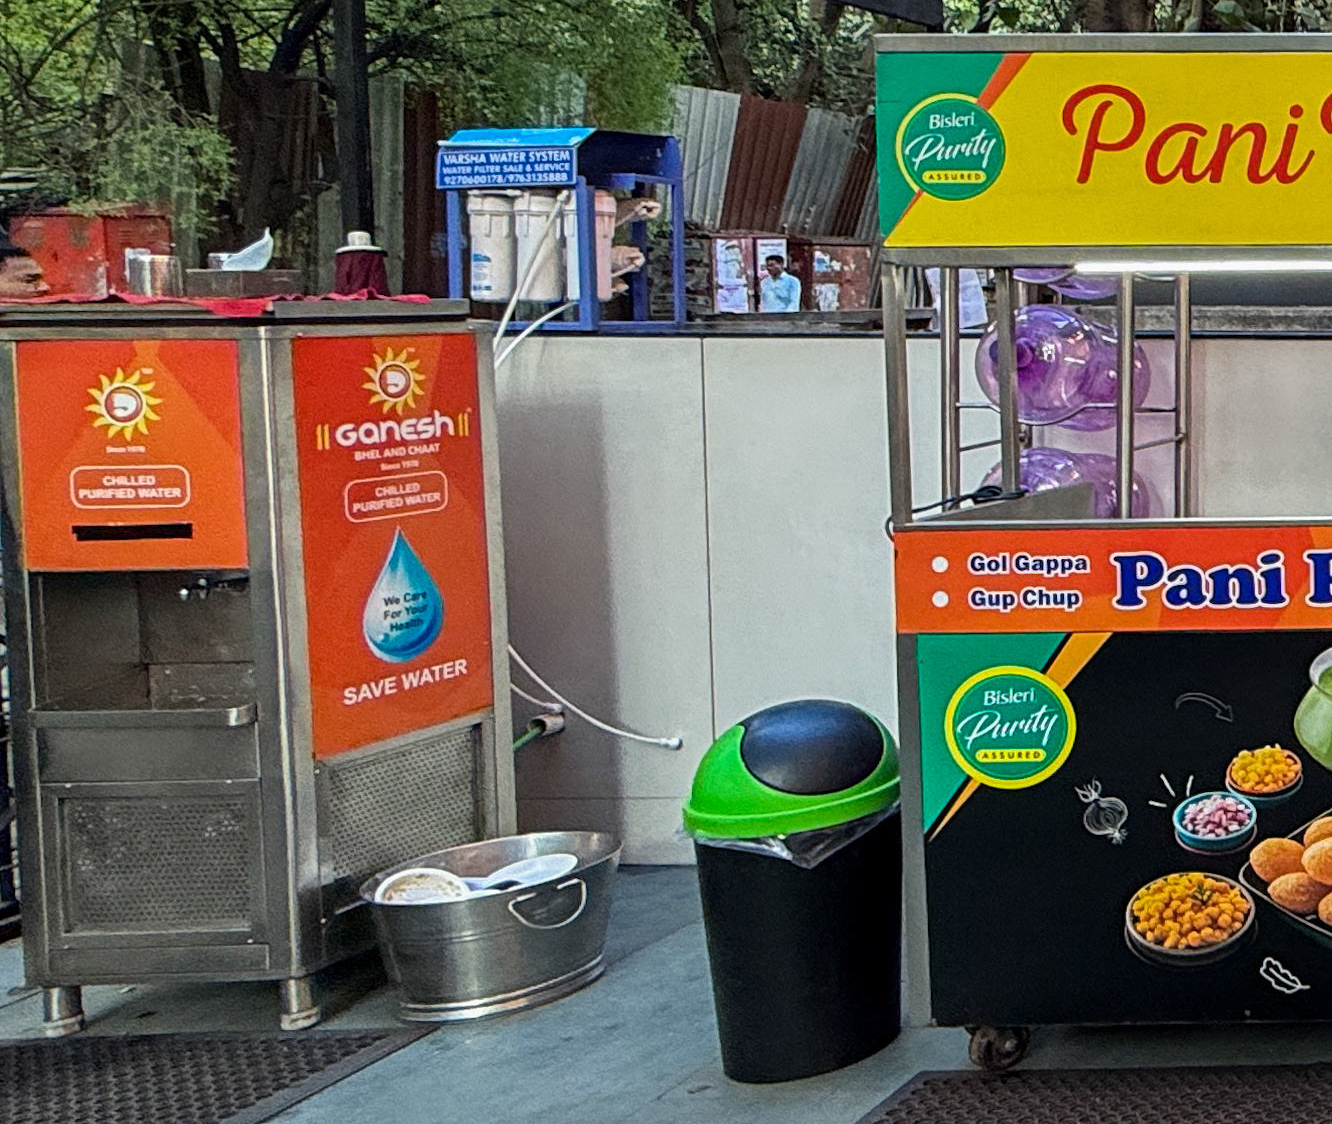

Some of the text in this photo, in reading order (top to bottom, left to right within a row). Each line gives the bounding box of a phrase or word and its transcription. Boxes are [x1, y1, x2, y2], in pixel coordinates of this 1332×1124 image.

[929, 111, 976, 129] Bisleri
[1062, 83, 1315, 185] Pani
[443, 150, 571, 165] VARSHA WATER SYSTEM
[905, 129, 997, 172] Purity
[442, 165, 473, 175] WATER
[474, 164, 501, 174] FILTER
[502, 164, 524, 173] SALE
[534, 162, 571, 172] SERVICE
[928, 173, 982, 181] ASSURED
[354, 443, 441, 461] BHEL AND CHAAT
[103, 475, 155, 486] CHILLED
[79, 487, 182, 499] PURIFIED WATER
[375, 482, 420, 497] CHILLED
[352, 492, 441, 513] PURIFIED WATER
[968, 554, 1007, 574] Gol
[1014, 554, 1090, 579] Gappa
[1111, 551, 1290, 609] Pani
[383, 591, 427, 607] We Care
[969, 589, 1016, 612] Gup
[1021, 589, 1081, 611] Chup
[383, 604, 429, 621] For Your
[390, 617, 424, 632] Health
[343, 658, 468, 705] SAVE WATER
[983, 687, 1035, 706] Bisleri
[956, 704, 1060, 751] Purity
[981, 751, 1041, 760] ASSURED
